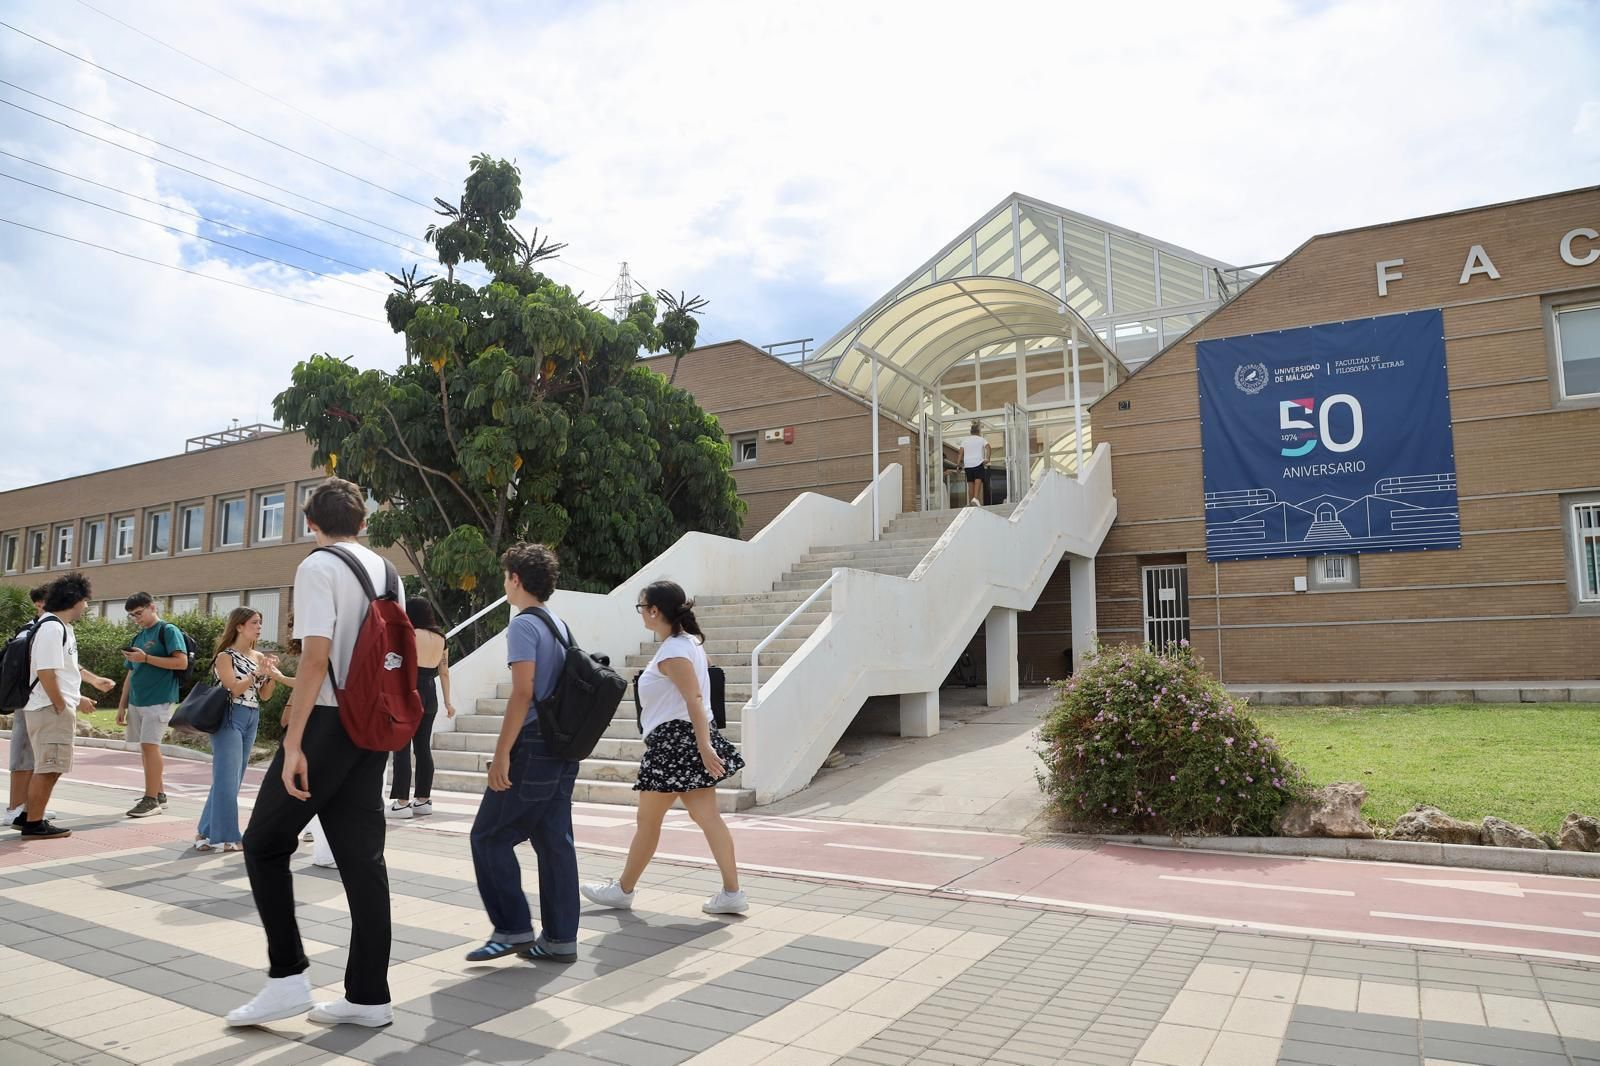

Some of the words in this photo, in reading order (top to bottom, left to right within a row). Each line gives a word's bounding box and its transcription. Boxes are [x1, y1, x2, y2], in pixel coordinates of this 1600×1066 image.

[1335, 356, 1370, 367] FACULTAD
[1371, 355, 1381, 363] DE
[1371, 363, 1377, 371] Y
[1378, 360, 1405, 369] LETRAS
[1274, 363, 1321, 375] UNIVERSIDAD
[1285, 371, 1314, 383] MÁLAGA
[1280, 393, 1364, 457] 50
[1282, 460, 1366, 479] ANIVERSARIO
